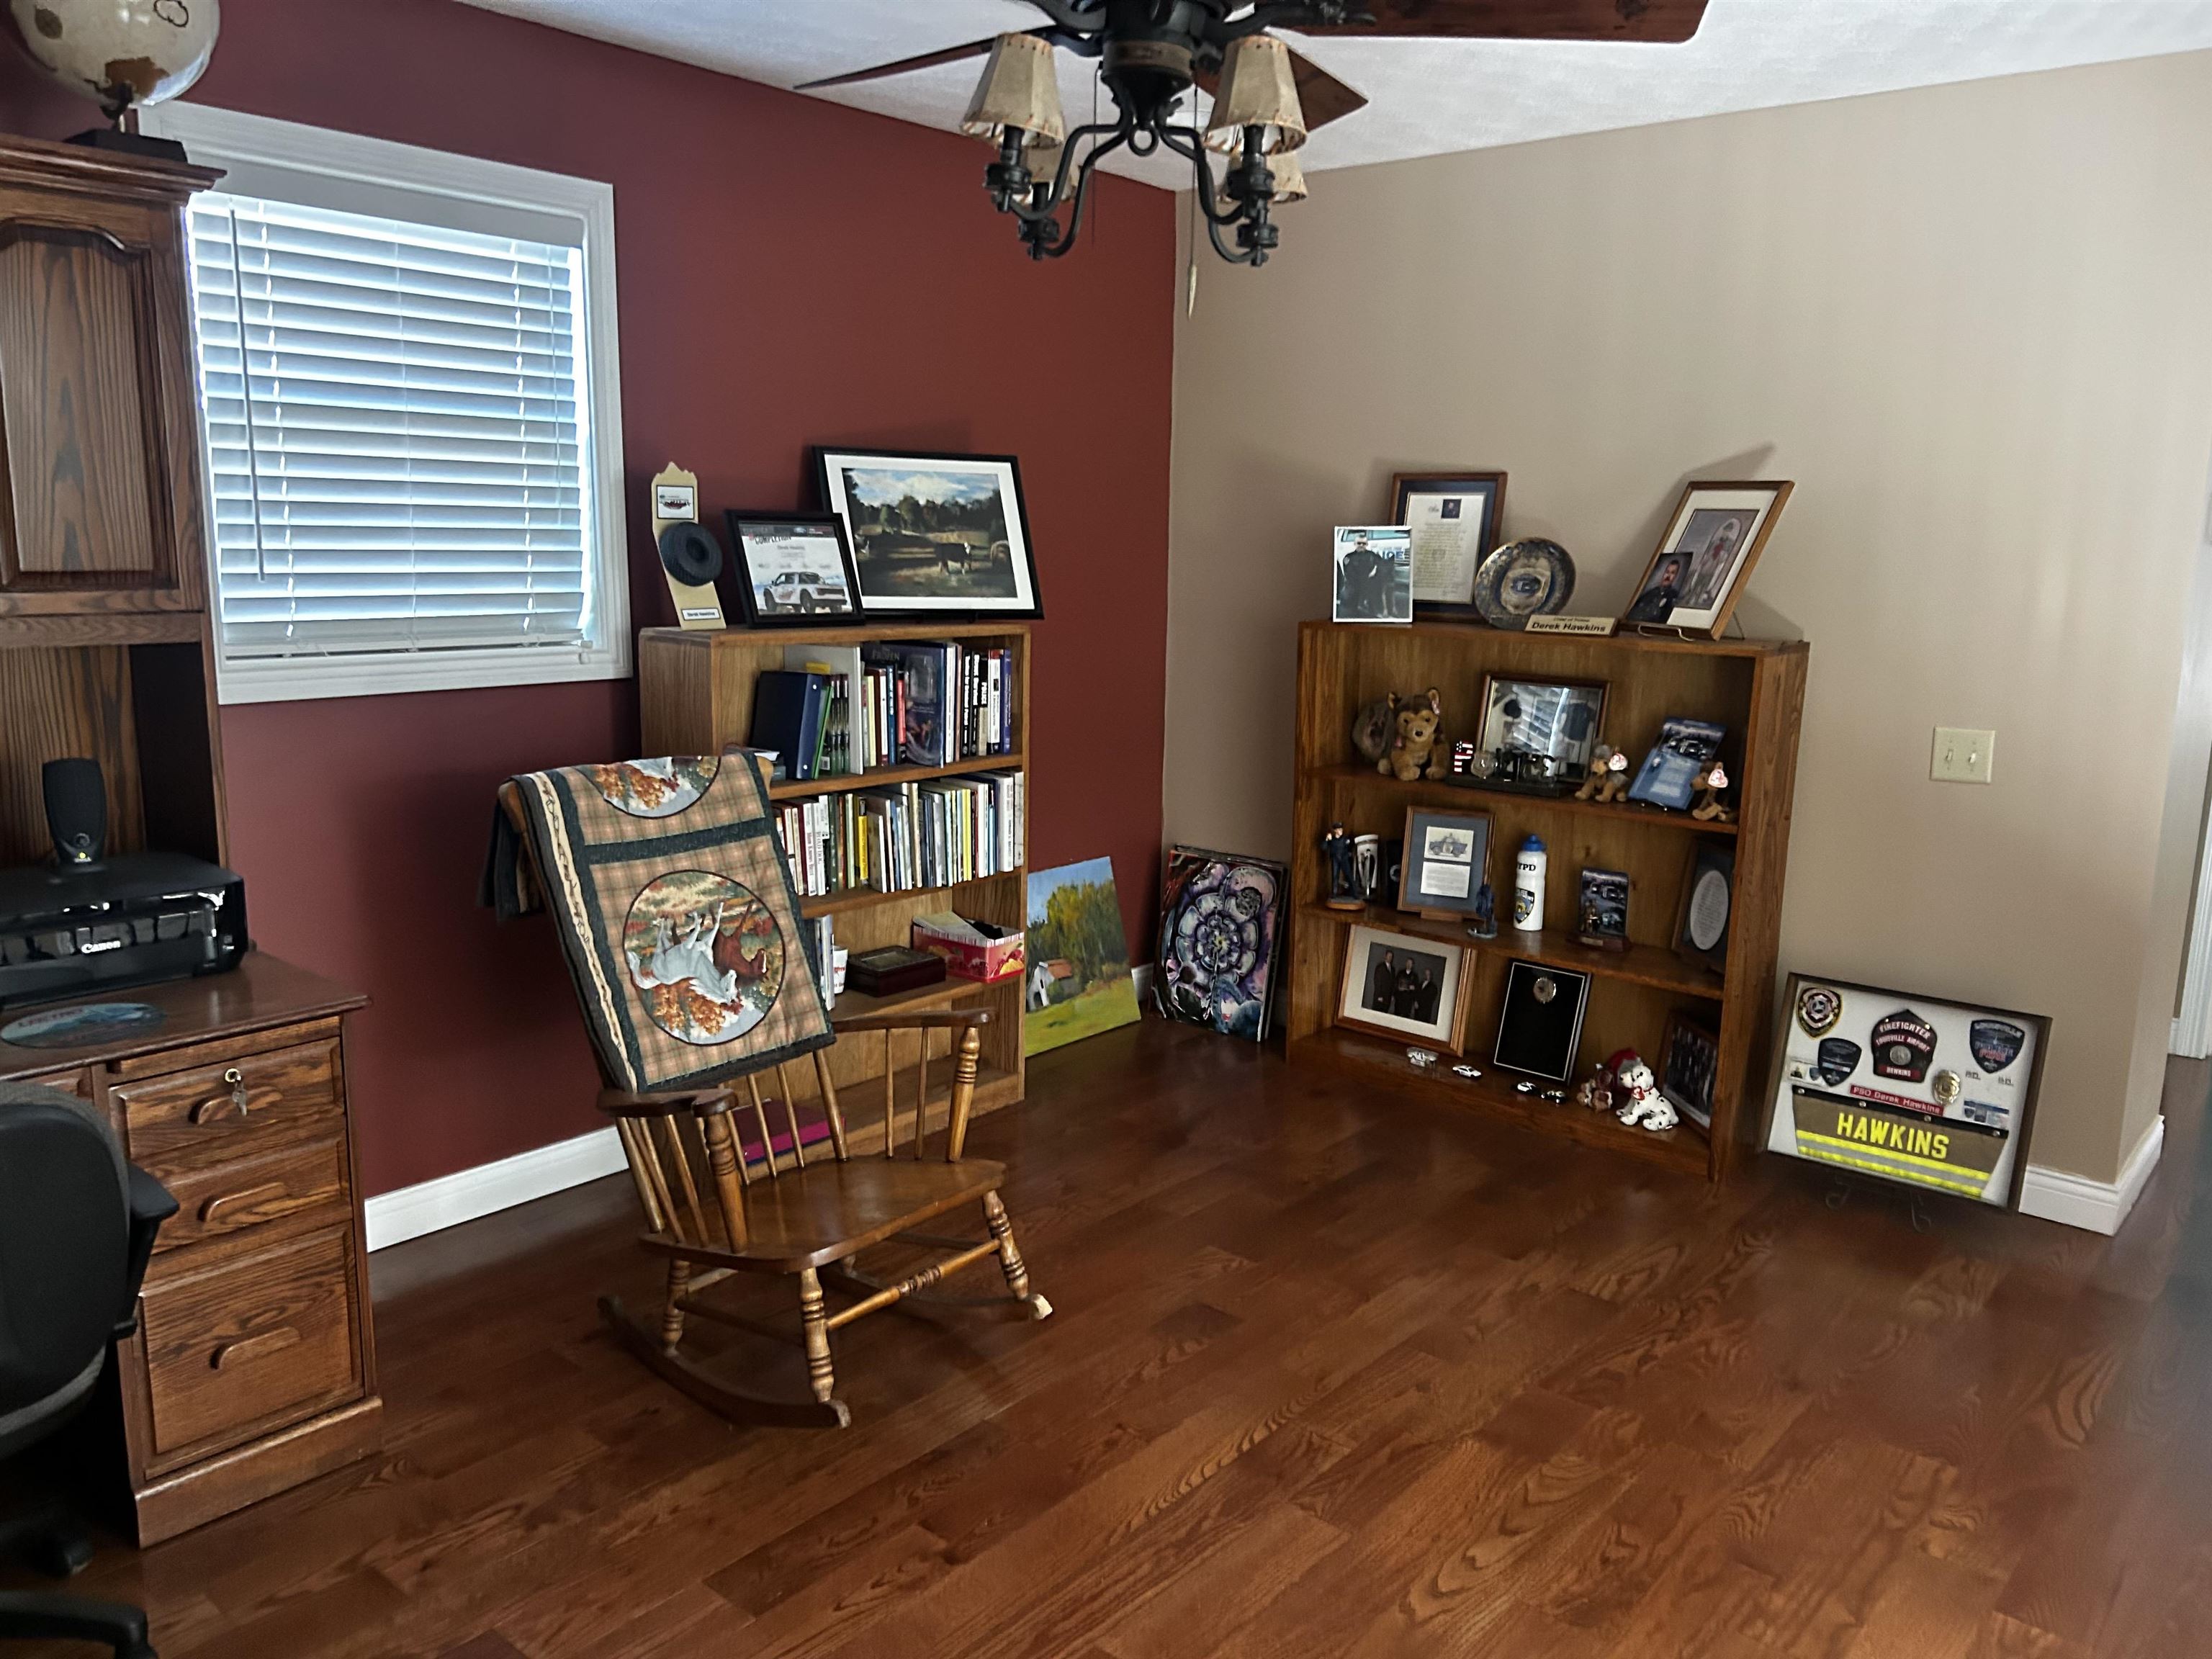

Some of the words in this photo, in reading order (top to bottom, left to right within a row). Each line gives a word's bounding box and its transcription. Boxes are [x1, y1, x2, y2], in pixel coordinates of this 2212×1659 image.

[1532, 621, 1560, 630] Derek
[1563, 623, 1606, 632] Hawkins
[1516, 863, 1536, 871] YPD
[81, 940, 121, 954] Canon
[1879, 1021, 1931, 1039] FIREFIGHTER
[1886, 1066, 1912, 1076] HAWKINS
[1874, 1090, 1899, 1104] Derek
[1903, 1098, 1941, 1114] Hawkins
[1837, 1112, 1950, 1160] HAWKINS
